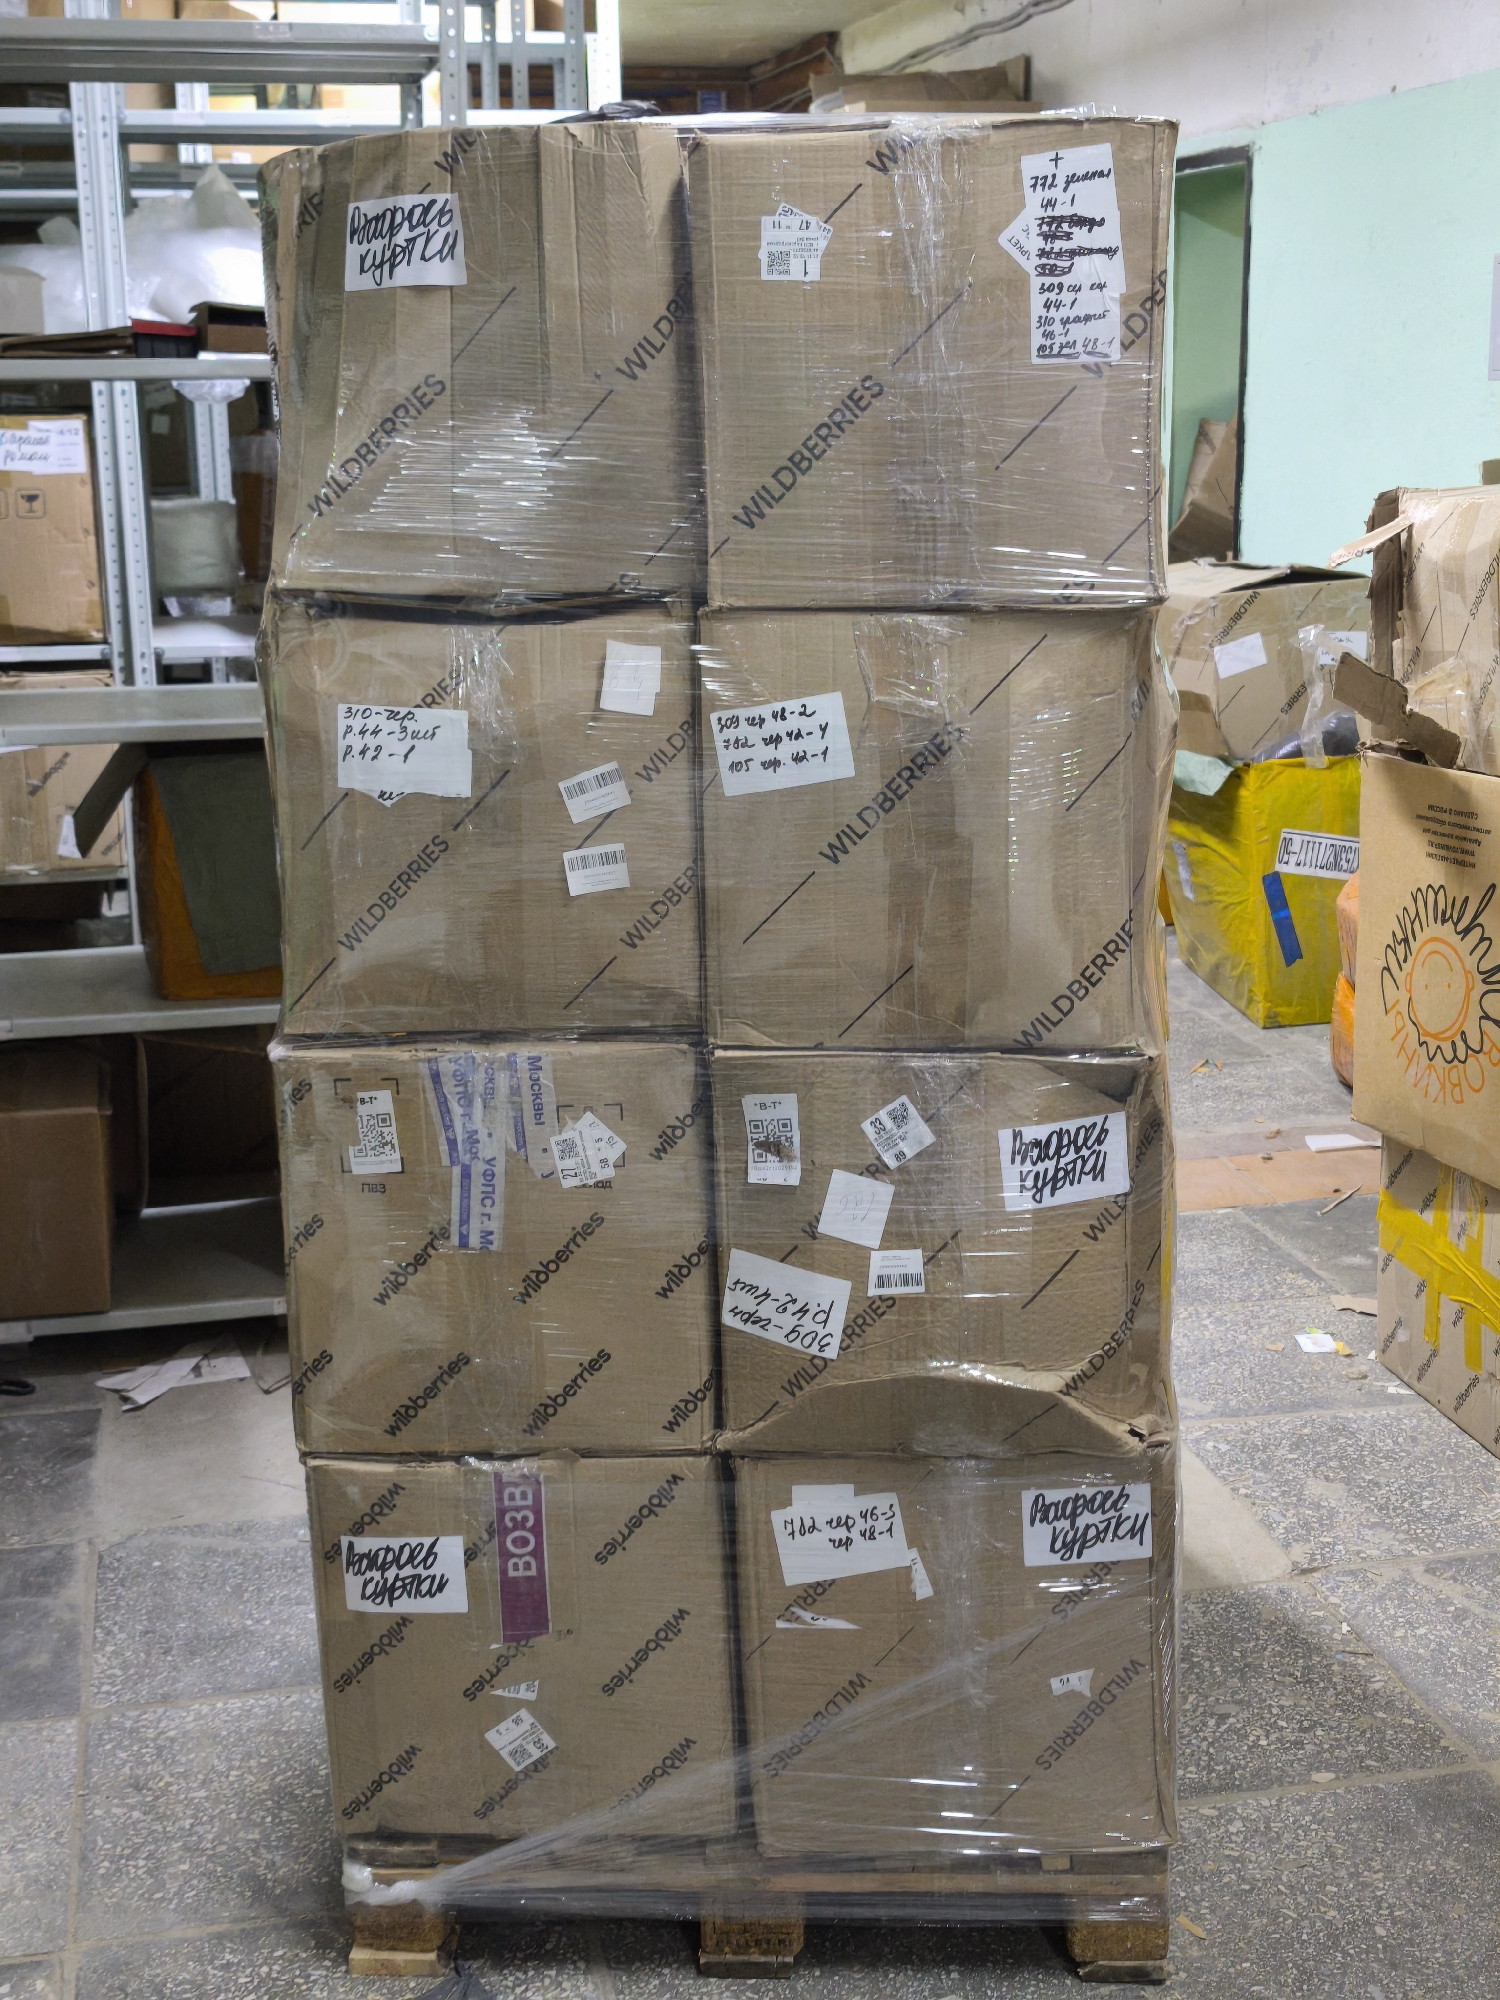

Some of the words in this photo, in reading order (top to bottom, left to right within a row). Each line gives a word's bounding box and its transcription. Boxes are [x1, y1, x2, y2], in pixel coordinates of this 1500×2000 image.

[1030, 174, 1057, 192] 772
[1036, 314, 1056, 331] 310
[1039, 281, 1064, 296] 309
[307, 373, 447, 518] WILDBERRIES
[733, 374, 885, 530] WILDBERRIES
[818, 722, 966, 865] WILDBERRIES
[337, 834, 451, 954] WILDBERRIES
[869, 1116, 887, 1136] 33
[361, 1182, 387, 1194] ПВЗ
[480, 1157, 497, 1208] УФПС
[514, 1211, 605, 1304] wildberries
[781, 1295, 897, 1399] WILDERRIES
[384, 1350, 471, 1438] wildberries
[522, 1347, 612, 1438] wildberries
[595, 1473, 685, 1565] wildberries
[333, 1615, 413, 1694] wildberries
[602, 1608, 690, 1697] wildberries
[1035, 1658, 1146, 1772] WILDBERRIES
[341, 1744, 422, 1820] wildberries
